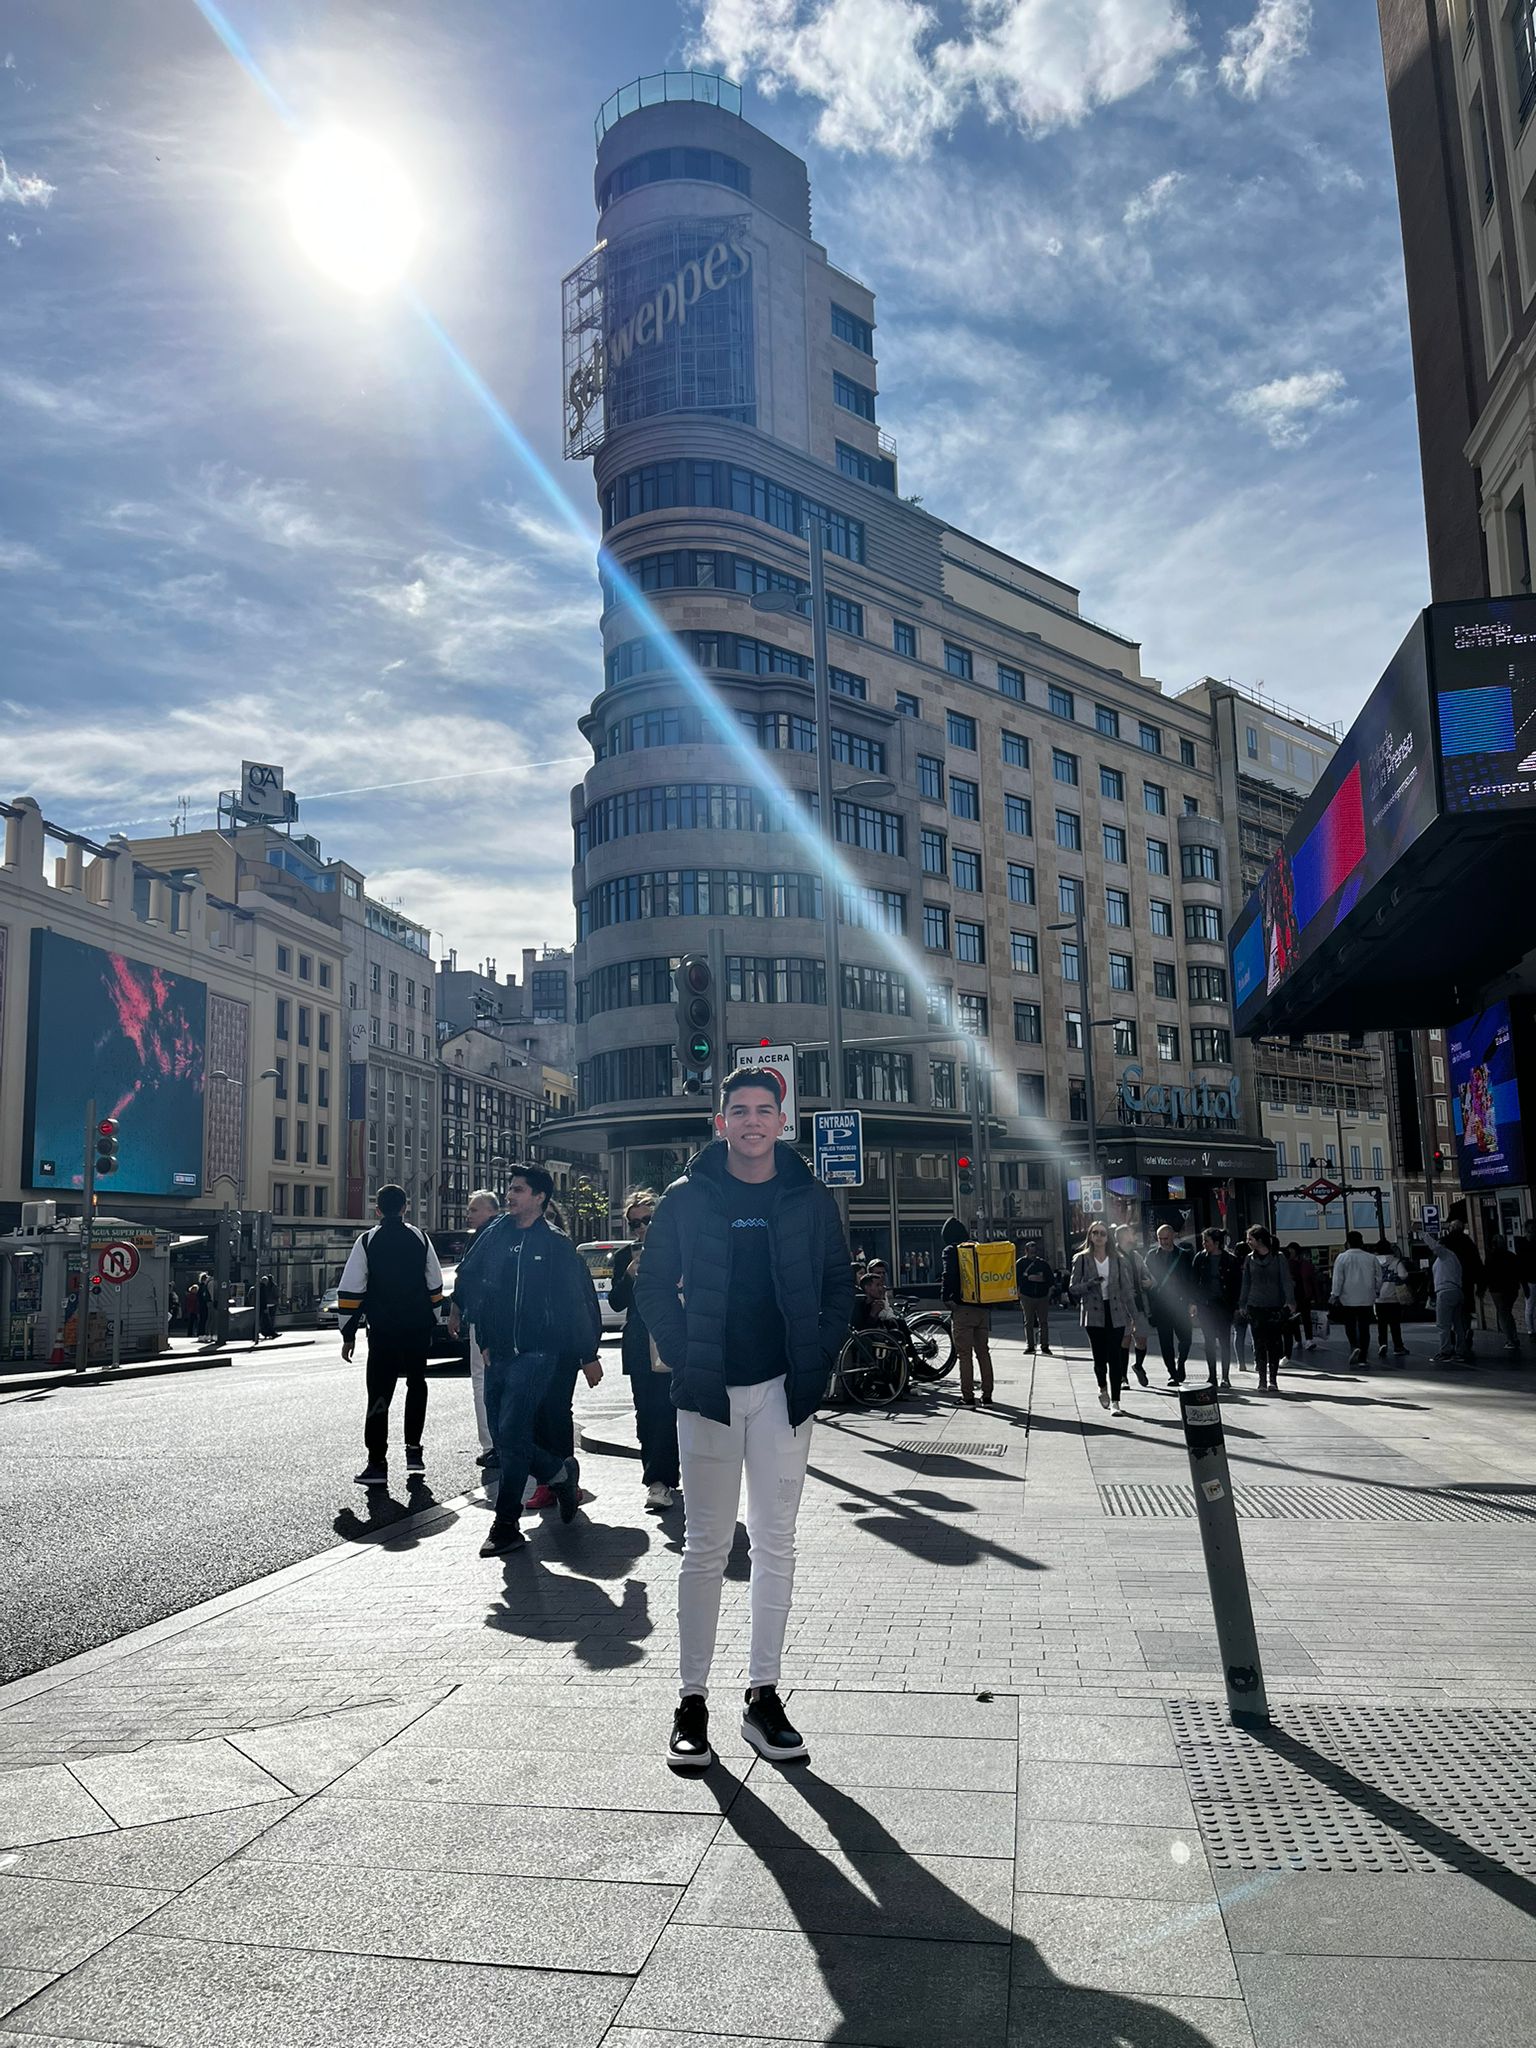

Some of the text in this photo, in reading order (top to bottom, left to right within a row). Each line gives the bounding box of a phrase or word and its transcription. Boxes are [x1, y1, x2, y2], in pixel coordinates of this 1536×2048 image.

[1454, 621, 1511, 637] Palacio
[1496, 633, 1536, 646] Pren
[1468, 781, 1530, 798] compra
[740, 1053, 790, 1065] EN ACERA
[1122, 1063, 1242, 1121] Capitol
[819, 1115, 856, 1129] ENTRADA
[822, 1128, 853, 1146] P
[1312, 1187, 1331, 1195] Metro
[1423, 1206, 1437, 1223] P
[980, 1271, 1012, 1283] Glovo
